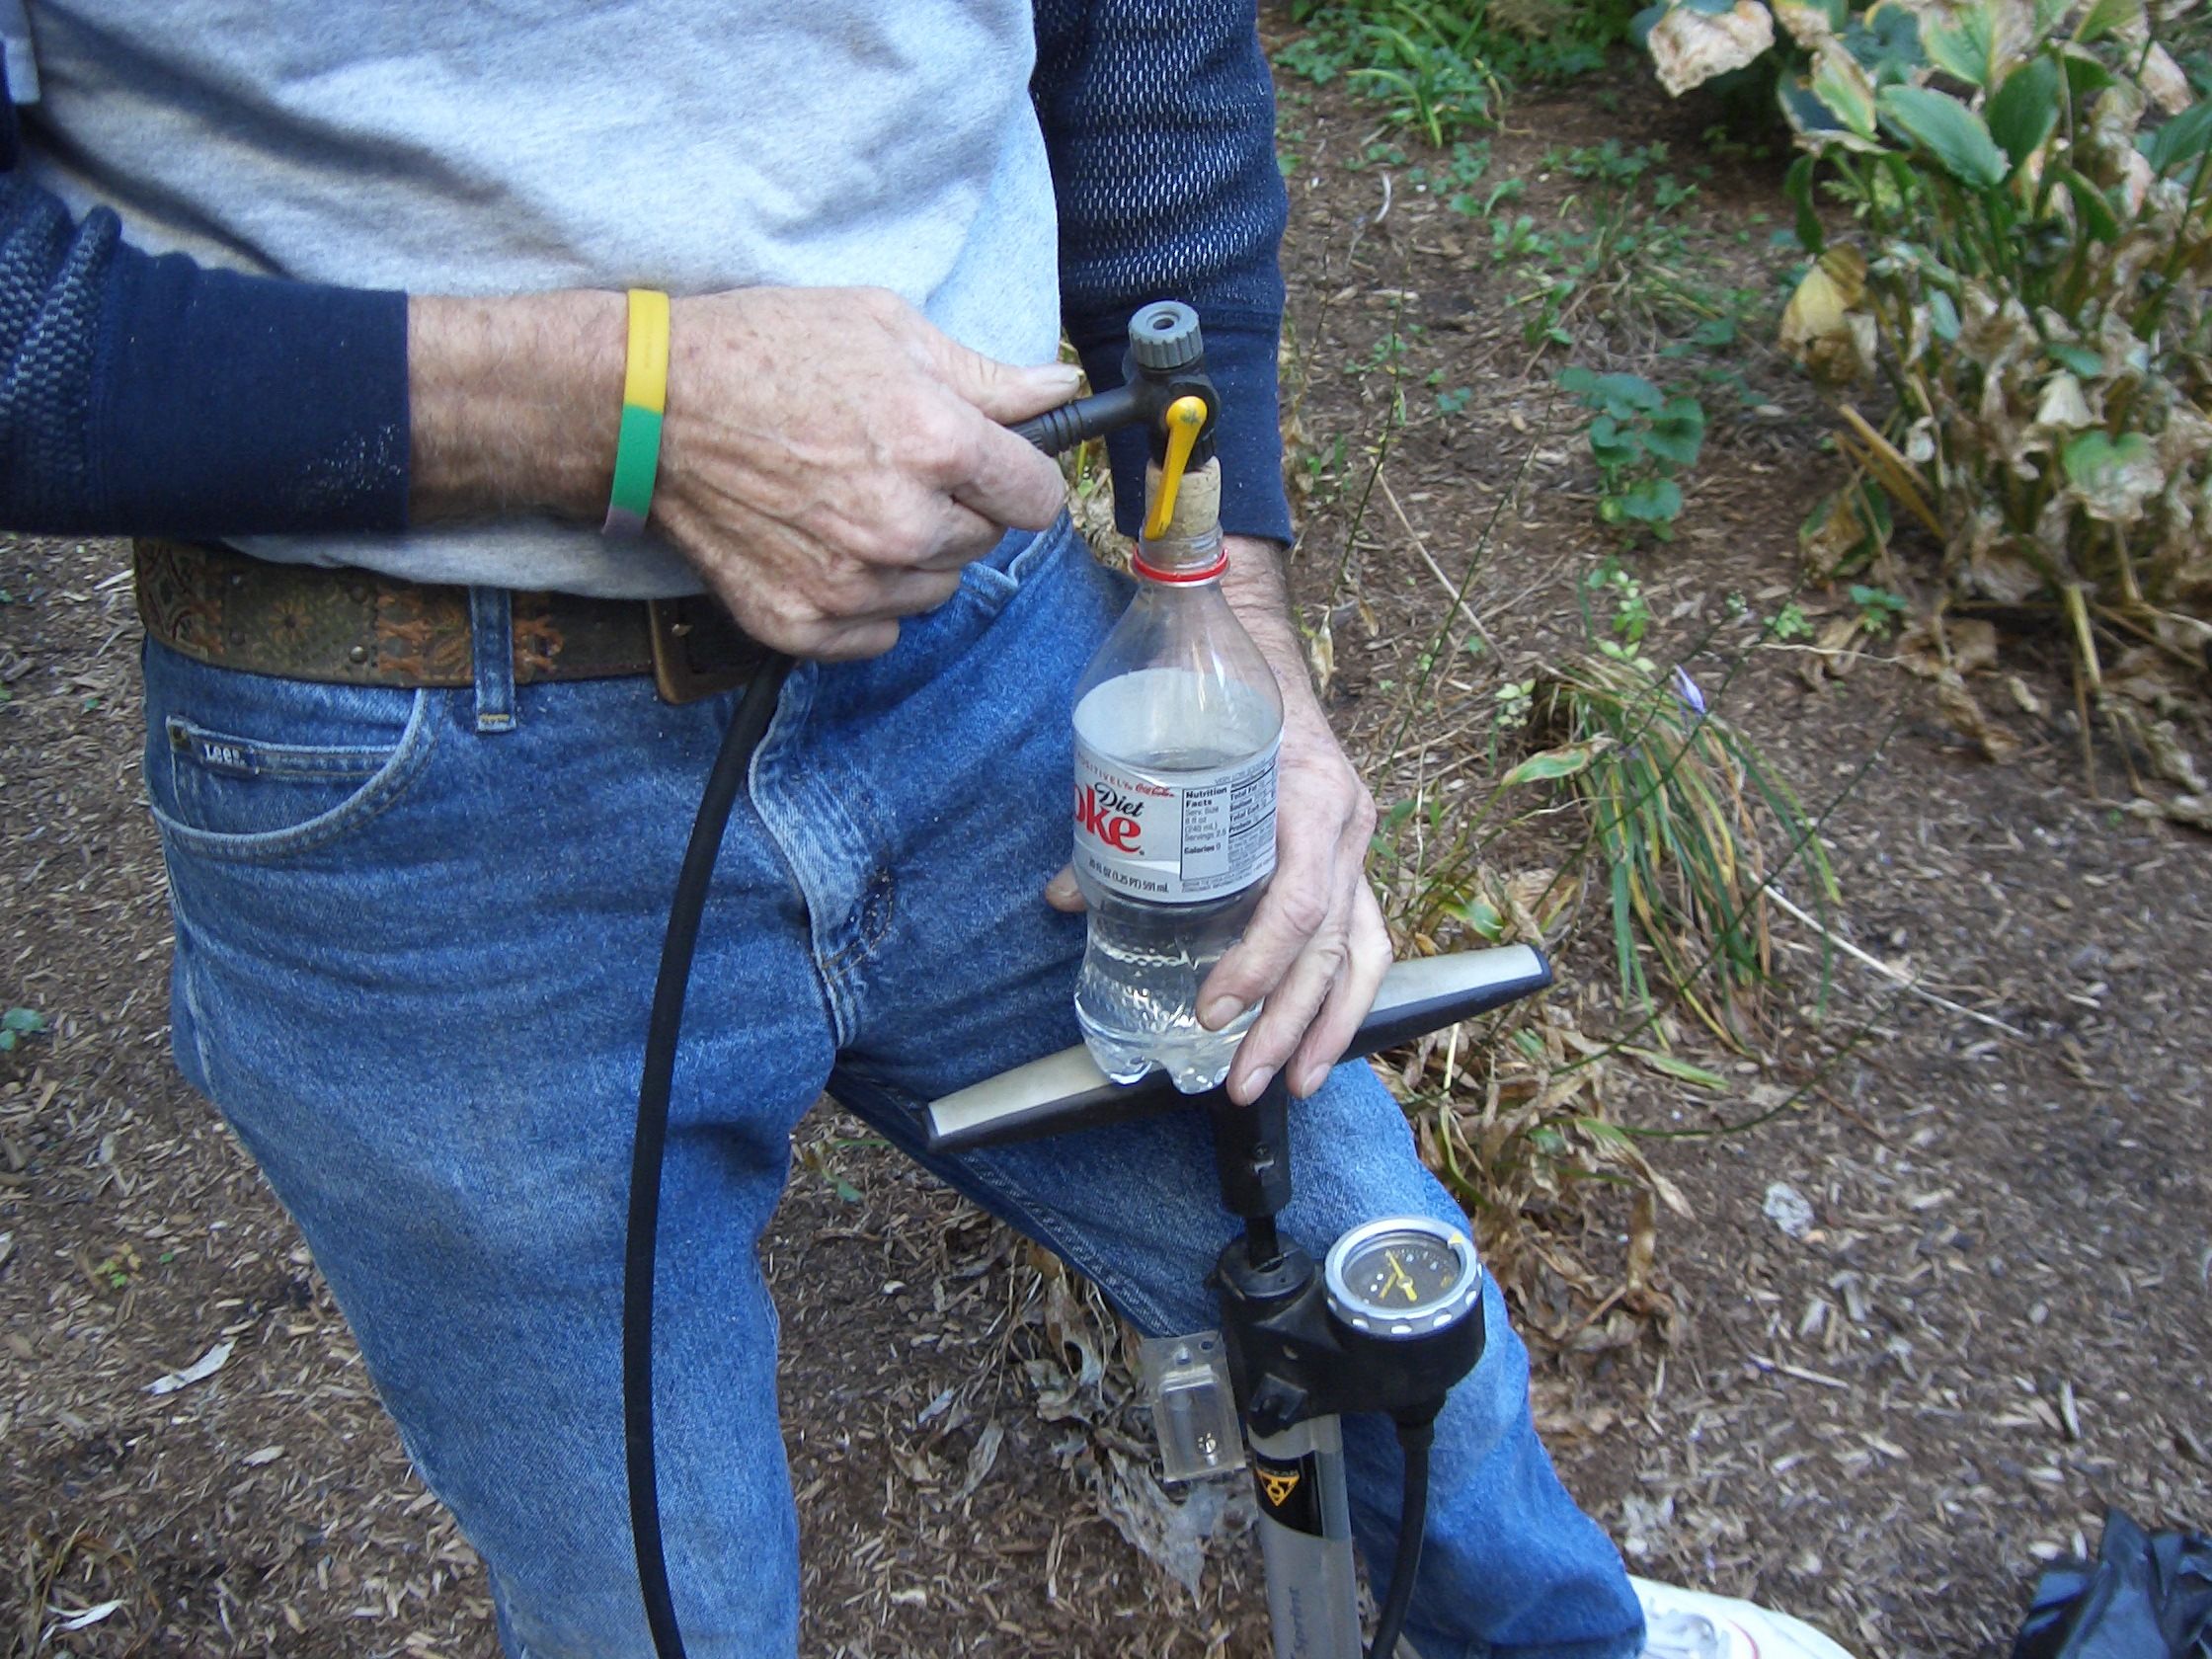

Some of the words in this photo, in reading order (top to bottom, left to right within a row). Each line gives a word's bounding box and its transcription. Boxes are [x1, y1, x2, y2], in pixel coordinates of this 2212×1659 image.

[1186, 787, 1227, 798] Nutrition
[1093, 781, 1145, 818] Diet
[1184, 844, 1215, 854] Calories
[1143, 880, 1156, 893] 591
